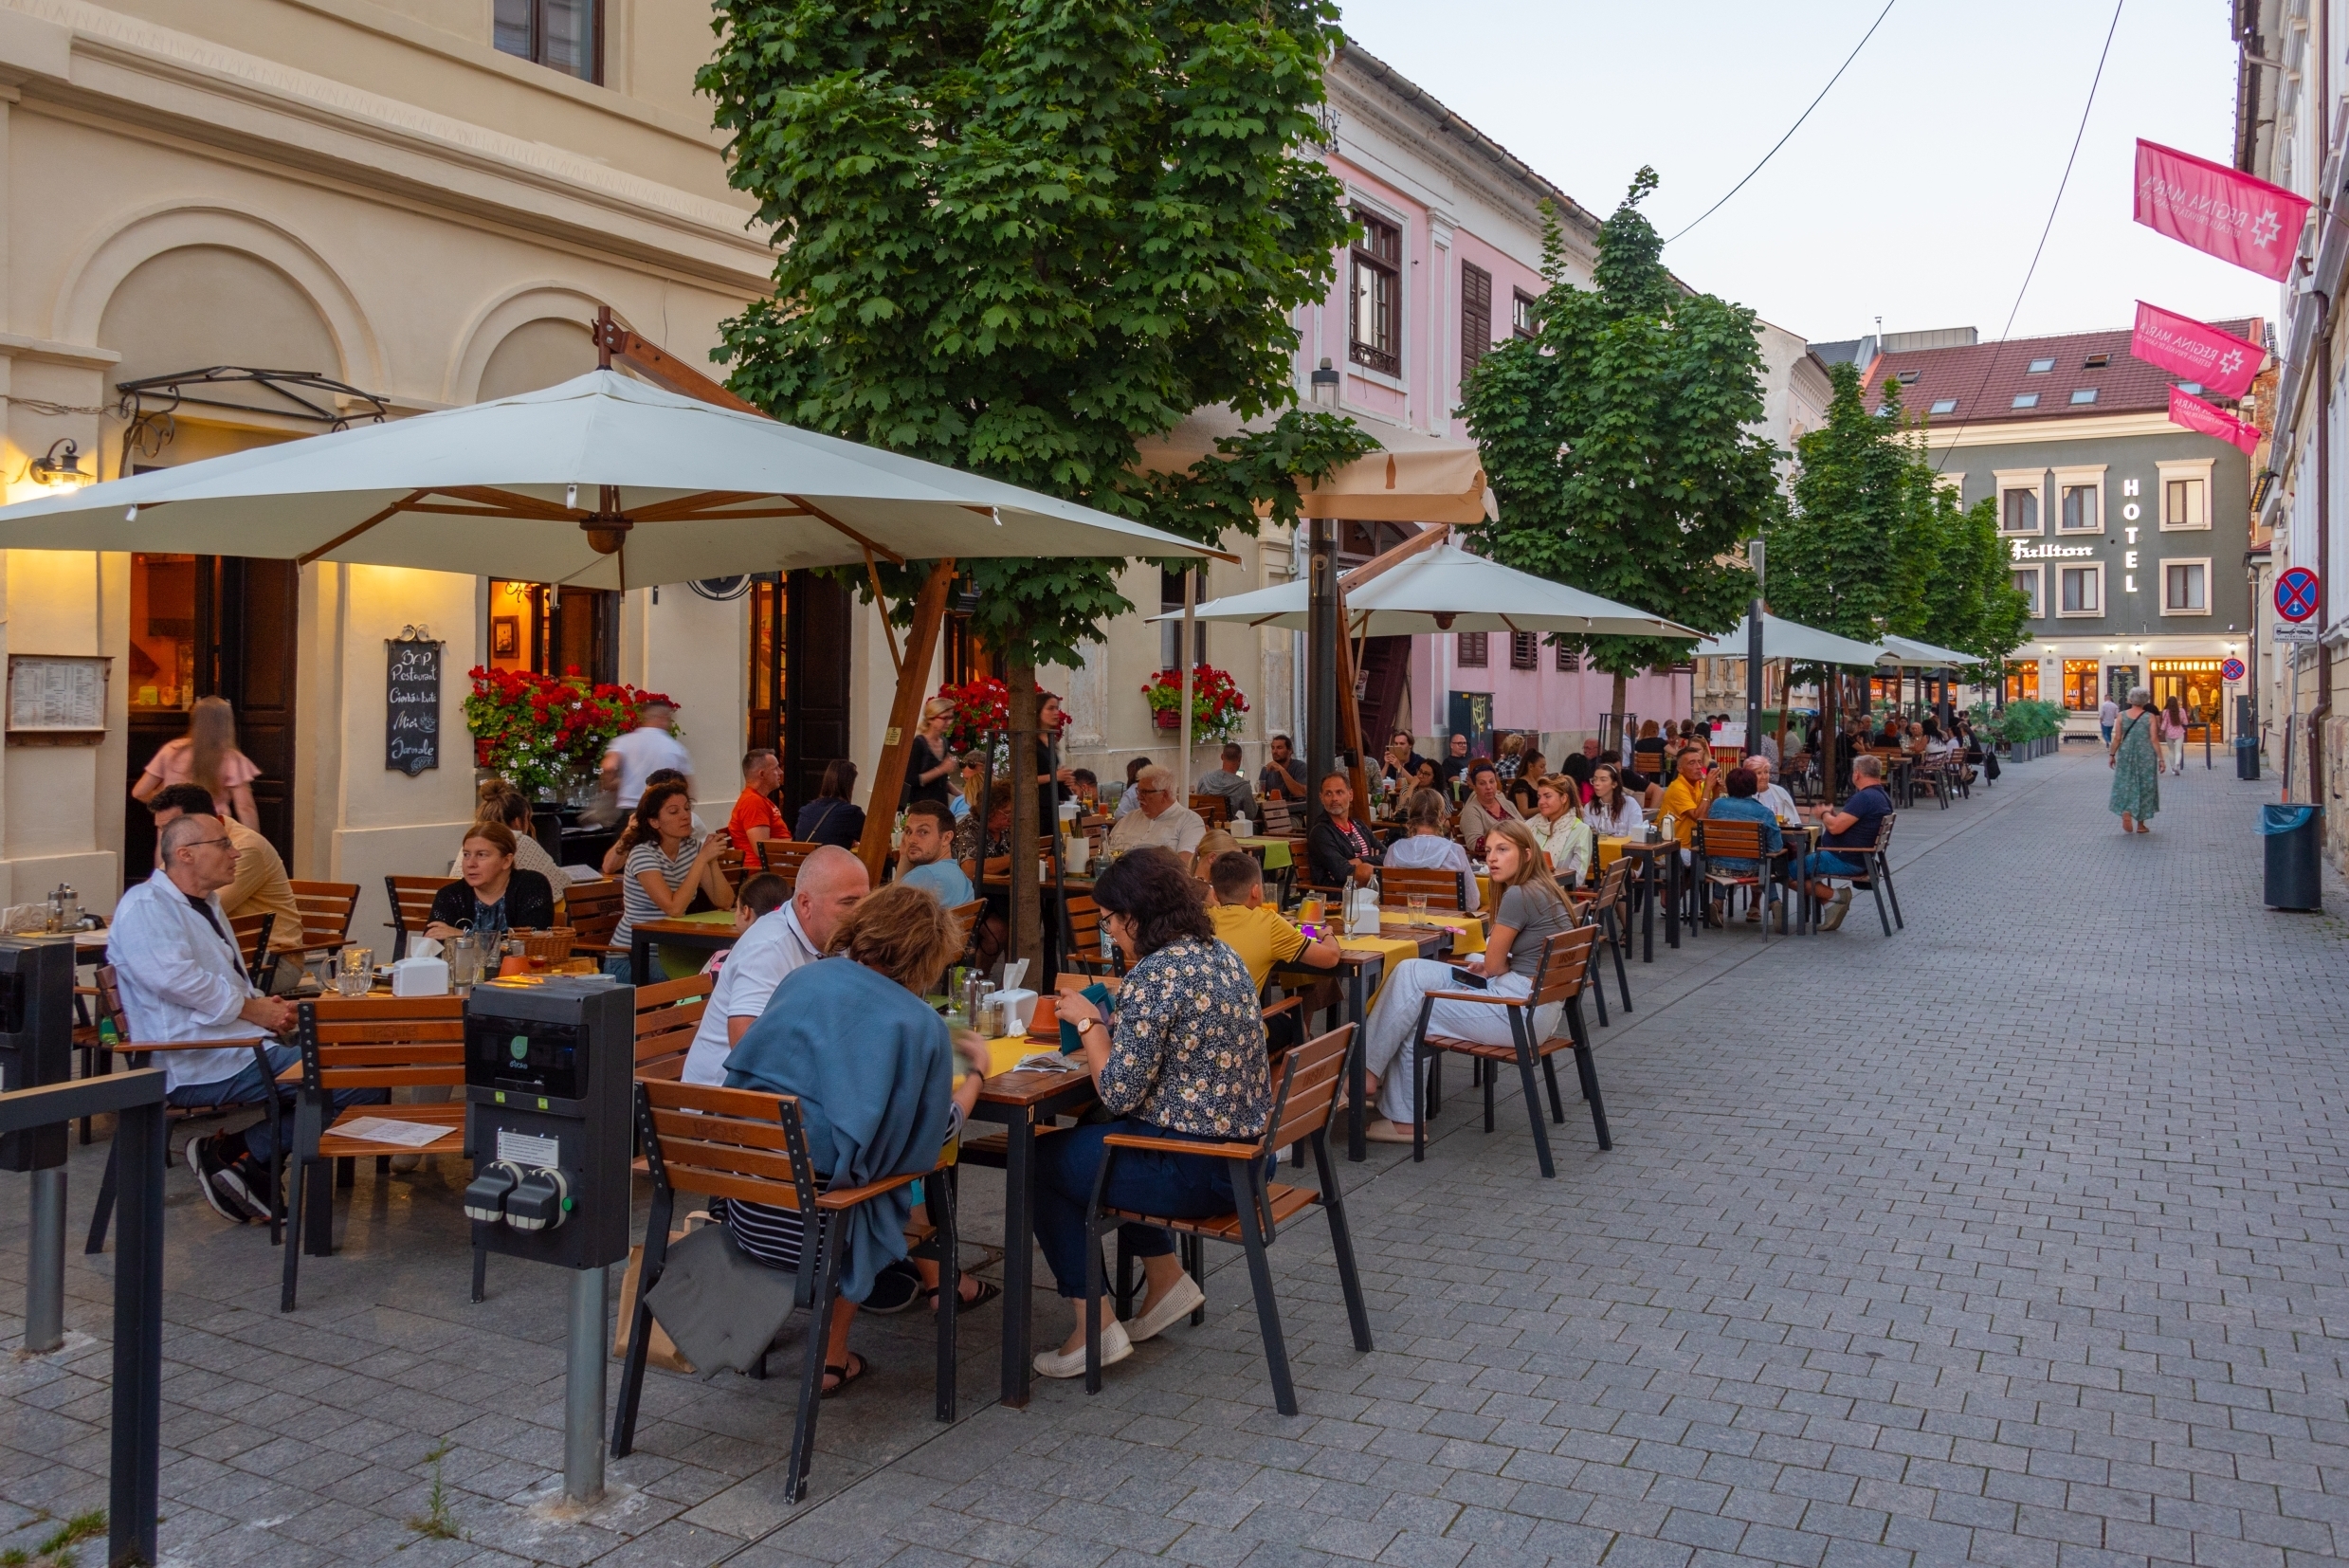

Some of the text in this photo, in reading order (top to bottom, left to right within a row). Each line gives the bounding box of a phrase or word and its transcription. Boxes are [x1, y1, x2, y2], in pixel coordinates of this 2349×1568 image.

[2123, 479, 2140, 593] HOTEL
[2009, 538, 2093, 560] Fullton
[401, 649, 432, 666] BAR
[2151, 661, 2222, 671] RESTAURANT
[391, 664, 437, 682] Restaurant
[392, 710, 418, 730] Mici
[391, 737, 434, 759] Sarmale
[1353, 965, 1358, 977] 1
